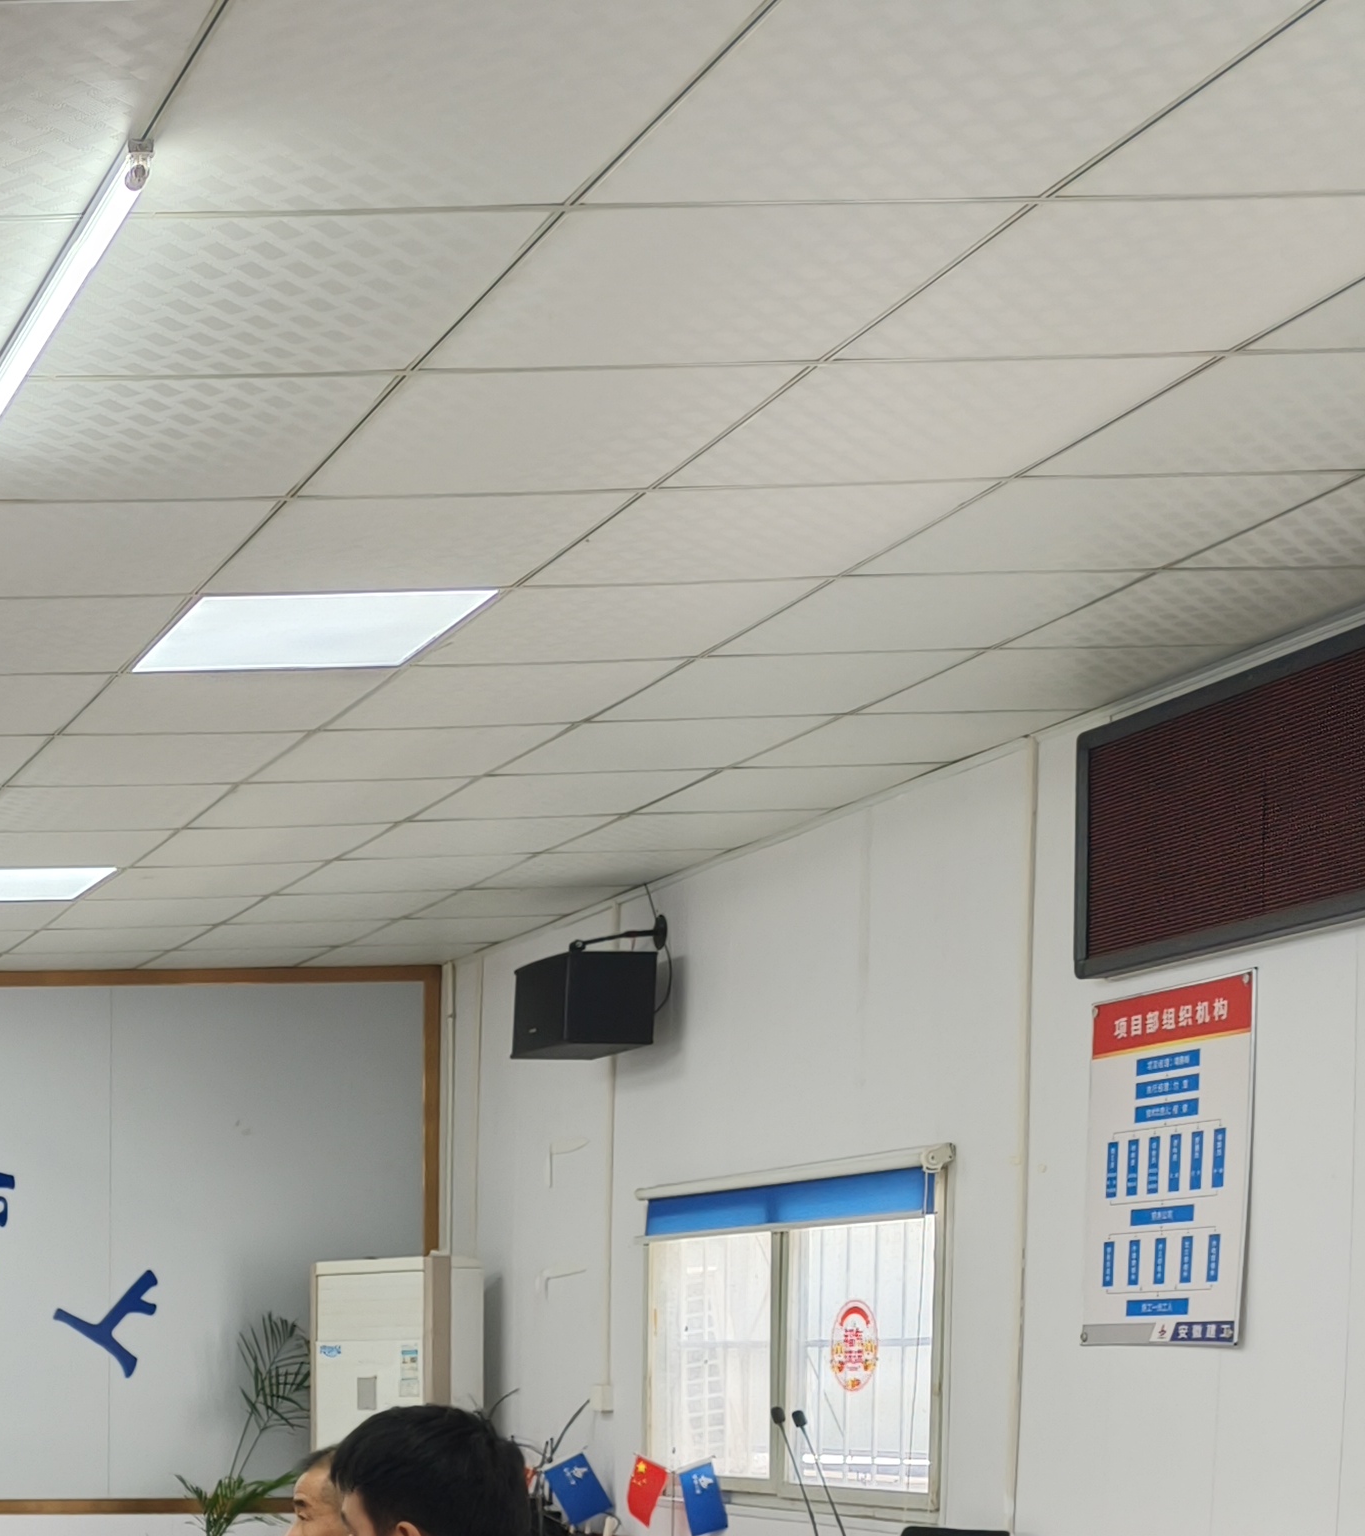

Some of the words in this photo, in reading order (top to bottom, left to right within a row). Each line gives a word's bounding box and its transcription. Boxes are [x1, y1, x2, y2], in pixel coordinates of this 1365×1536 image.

[1113, 998, 1229, 1040] 项目部组织机构
